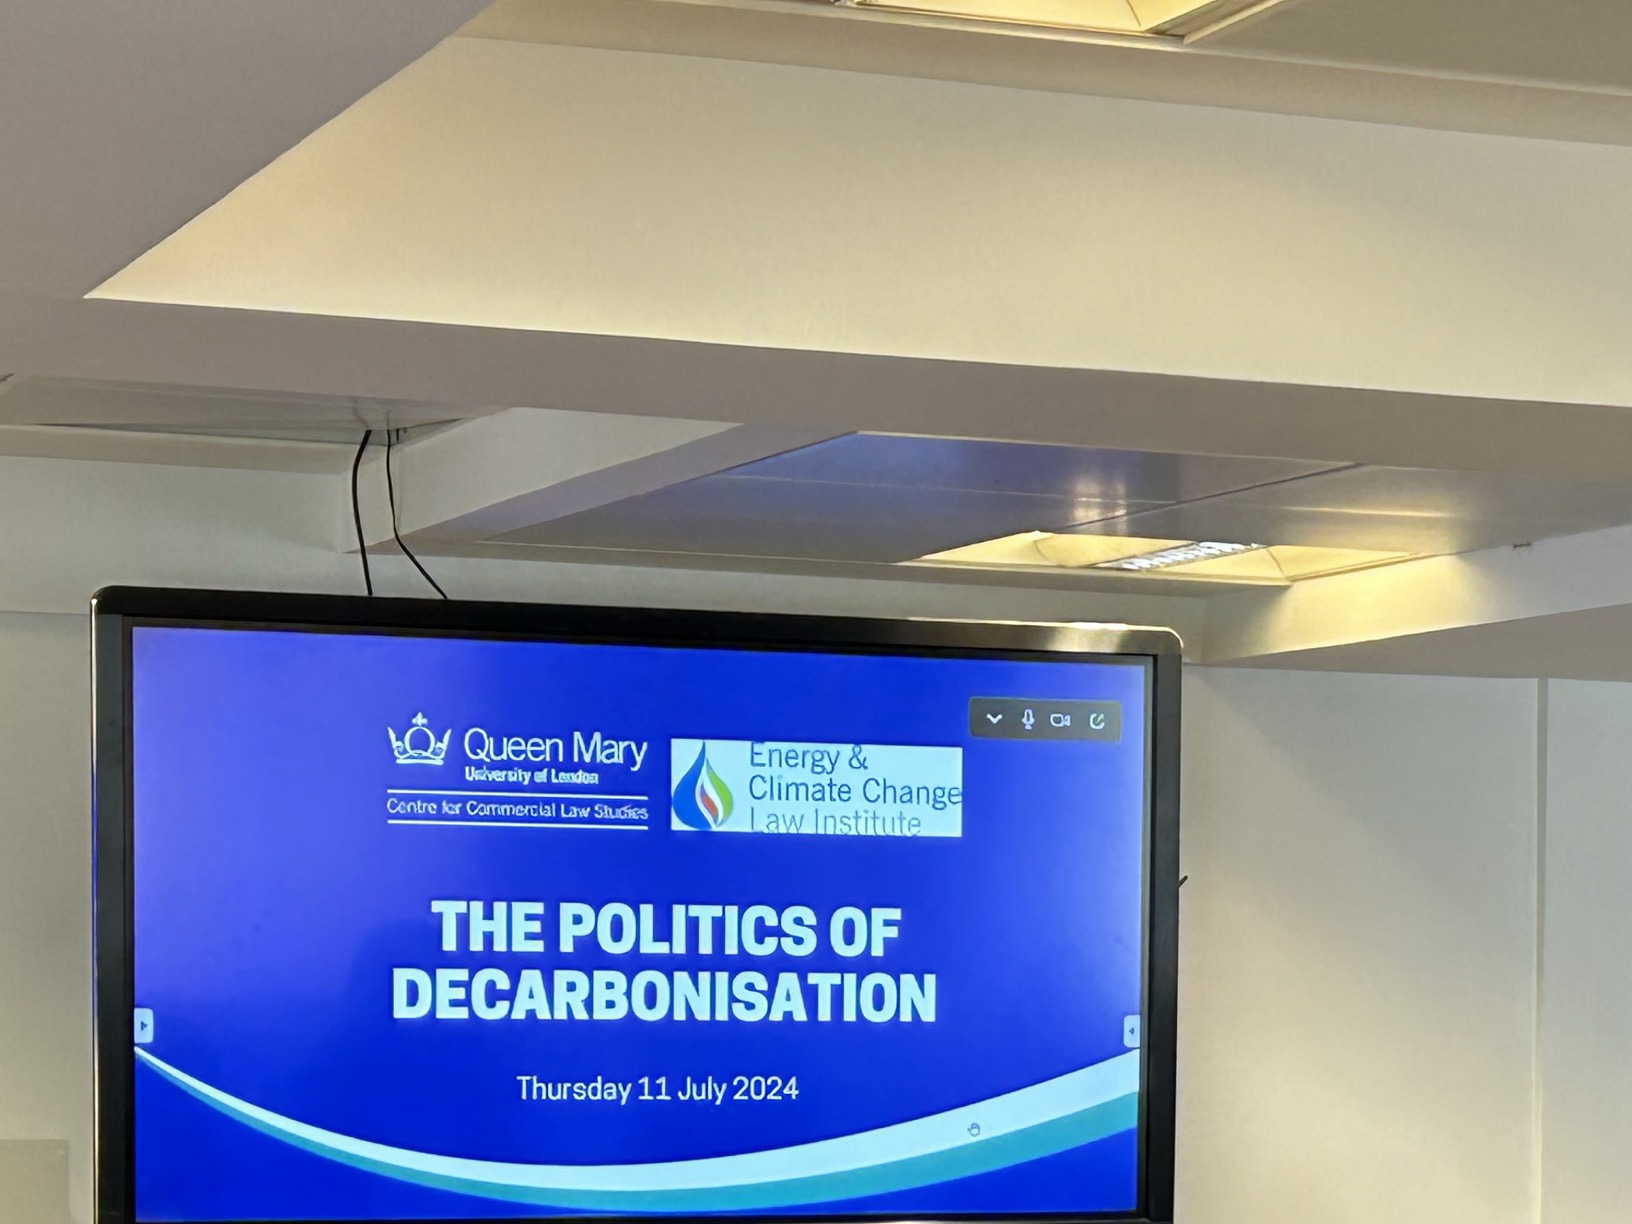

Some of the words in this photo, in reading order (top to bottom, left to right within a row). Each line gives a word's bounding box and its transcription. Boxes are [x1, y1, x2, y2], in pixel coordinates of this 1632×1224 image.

[464, 727, 563, 762] Queen
[573, 731, 648, 771] Mary
[750, 741, 840, 775] Energy
[848, 744, 868, 770] &
[465, 765, 530, 785] University
[534, 768, 549, 783] of
[551, 769, 599, 784] London
[386, 798, 437, 815] Centre
[441, 799, 462, 815] for
[466, 800, 556, 818] Commercial
[560, 803, 591, 818] Law
[594, 803, 649, 820] Studies
[749, 774, 852, 802] Climate
[862, 777, 962, 811] Change
[750, 807, 804, 833] Law
[815, 808, 922, 836] Institute
[430, 900, 544, 953] THE
[560, 902, 816, 956] POLITICS
[830, 907, 902, 957] OF
[392, 967, 936, 1023] DECARBONISATION
[516, 1075, 631, 1106] Thursday
[637, 1077, 671, 1101] 11
[677, 1077, 728, 1107] July
[733, 1077, 799, 1101] 2024
